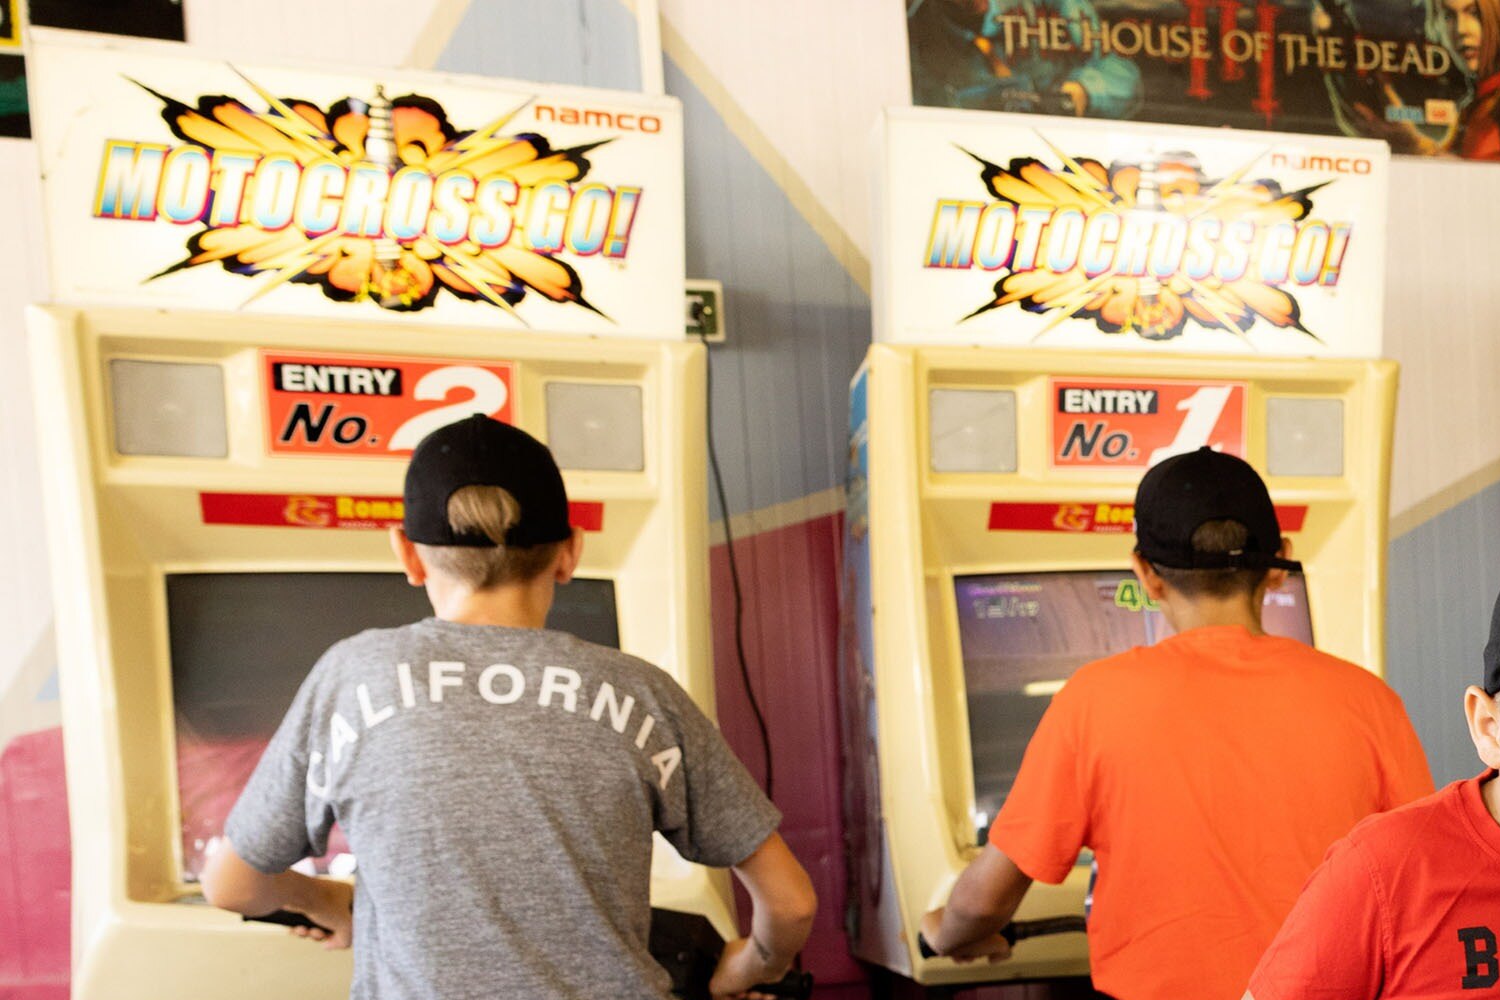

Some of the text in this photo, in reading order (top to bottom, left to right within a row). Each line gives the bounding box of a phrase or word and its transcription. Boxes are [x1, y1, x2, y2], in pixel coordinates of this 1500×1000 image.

[997, 13, 1451, 77] THE HOUSE OF THE DEAD
[534, 103, 662, 135] namco
[92, 138, 644, 259] MOTOCROSS GO!
[923, 198, 1355, 288] MOTOCROSS GO!
[281, 363, 397, 396] ENTRY
[1065, 387, 1155, 415] ENTRY
[279, 403, 381, 447] No.
[1059, 421, 1139, 461] No.
[306, 660, 683, 799] CALIFORNIA
